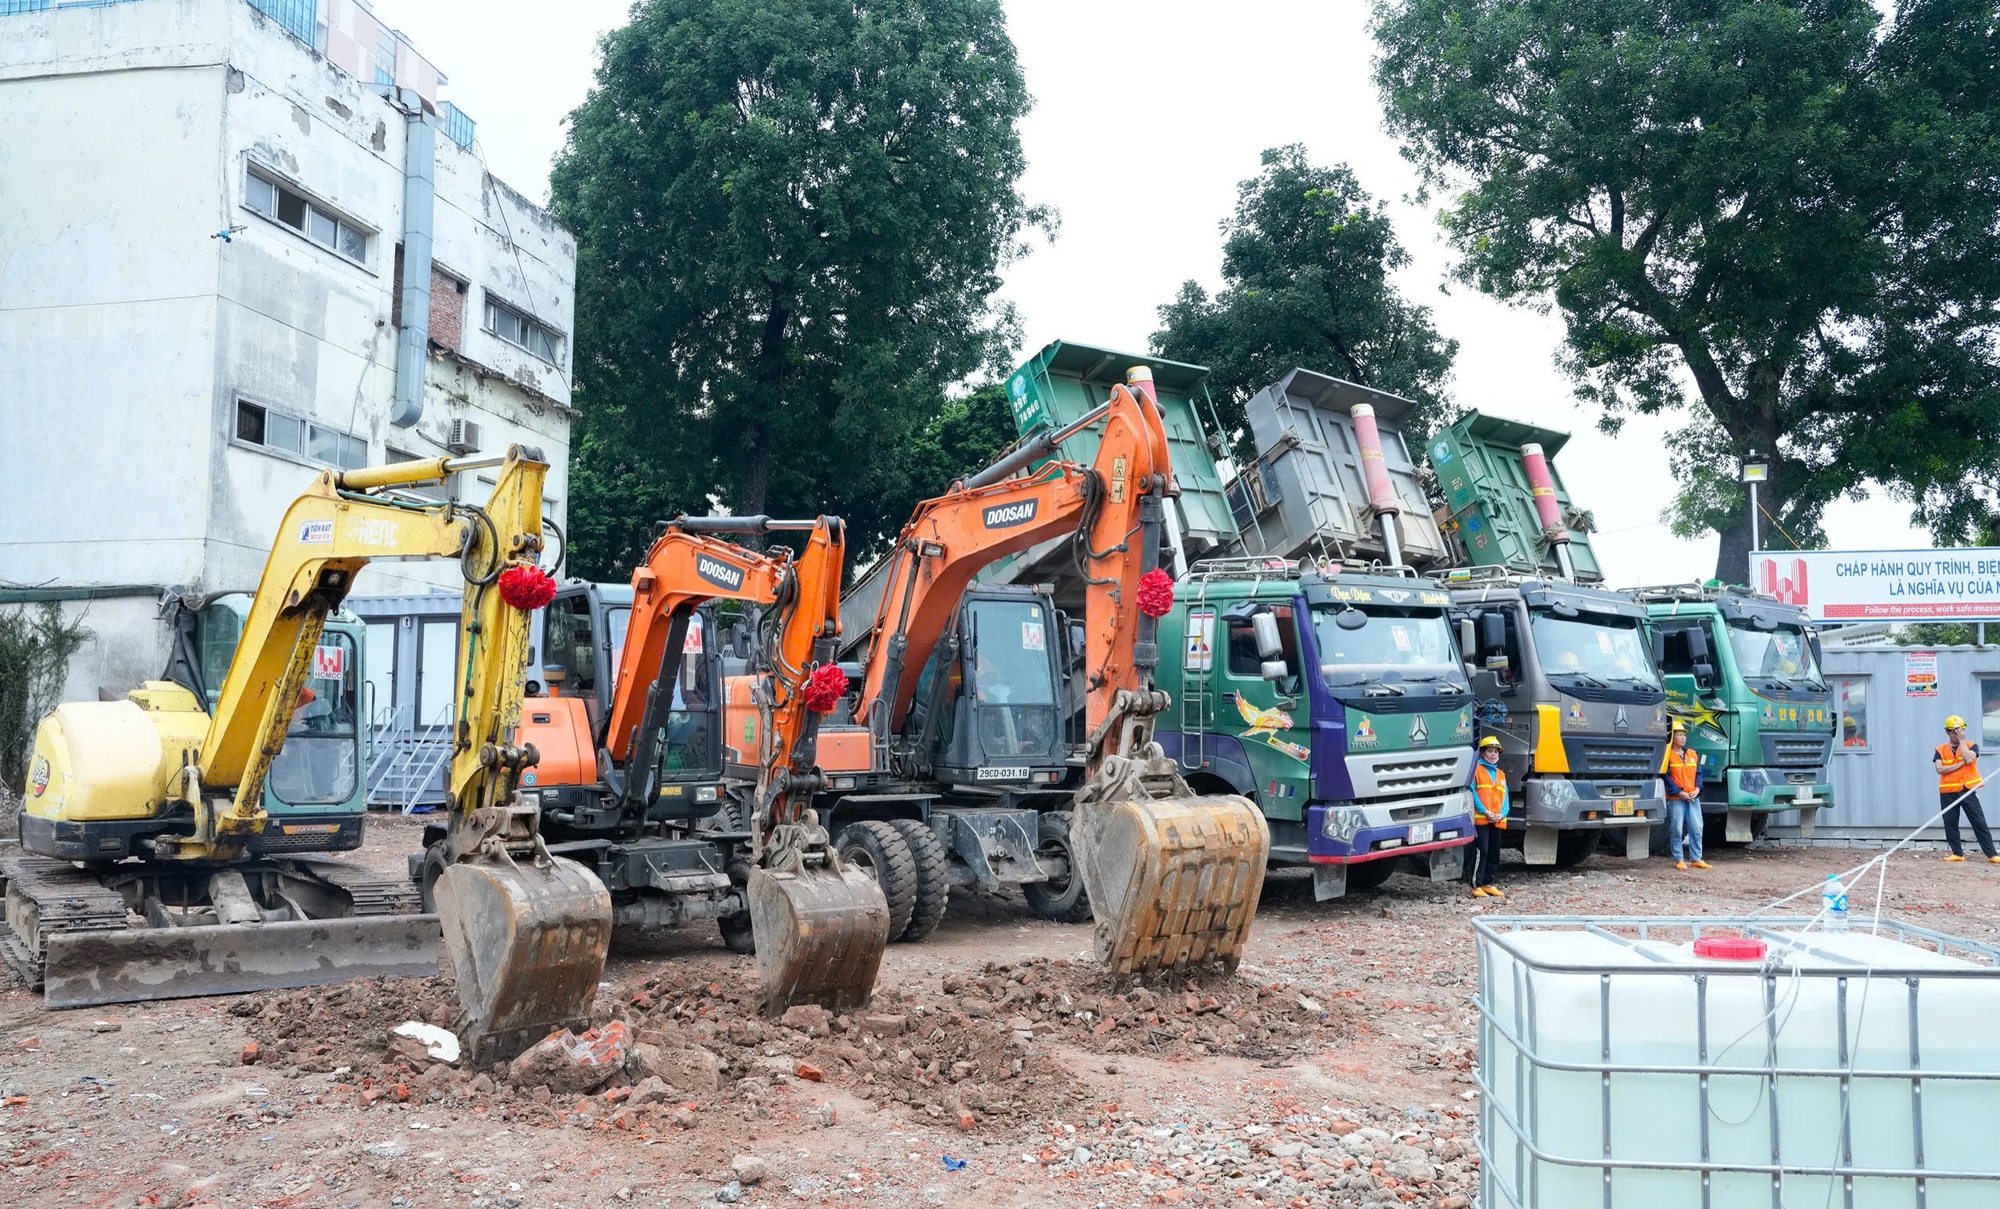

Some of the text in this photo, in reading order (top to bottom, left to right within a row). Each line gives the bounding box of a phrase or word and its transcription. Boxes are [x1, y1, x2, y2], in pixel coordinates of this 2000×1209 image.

[986, 503, 1034, 526] DOOSAN
[699, 559, 740, 586] DOOSAN
[1871, 559, 1903, 576] HÀNH
[1907, 562, 1932, 576] QUY
[1935, 558, 1974, 576] TRÌNH,
[1889, 578, 1905, 595] LÀ
[1908, 578, 1945, 595] NGHĨA
[1948, 581, 1964, 598] VỤ
[1967, 577, 1993, 595] CỦA
[1864, 605, 1888, 613] Follow
[1890, 605, 1901, 613] the
[1903, 606, 1934, 615] process,
[1936, 605, 1954, 613] work
[1956, 604, 1971, 612] safe
[1351, 741, 1380, 749] HOWO
